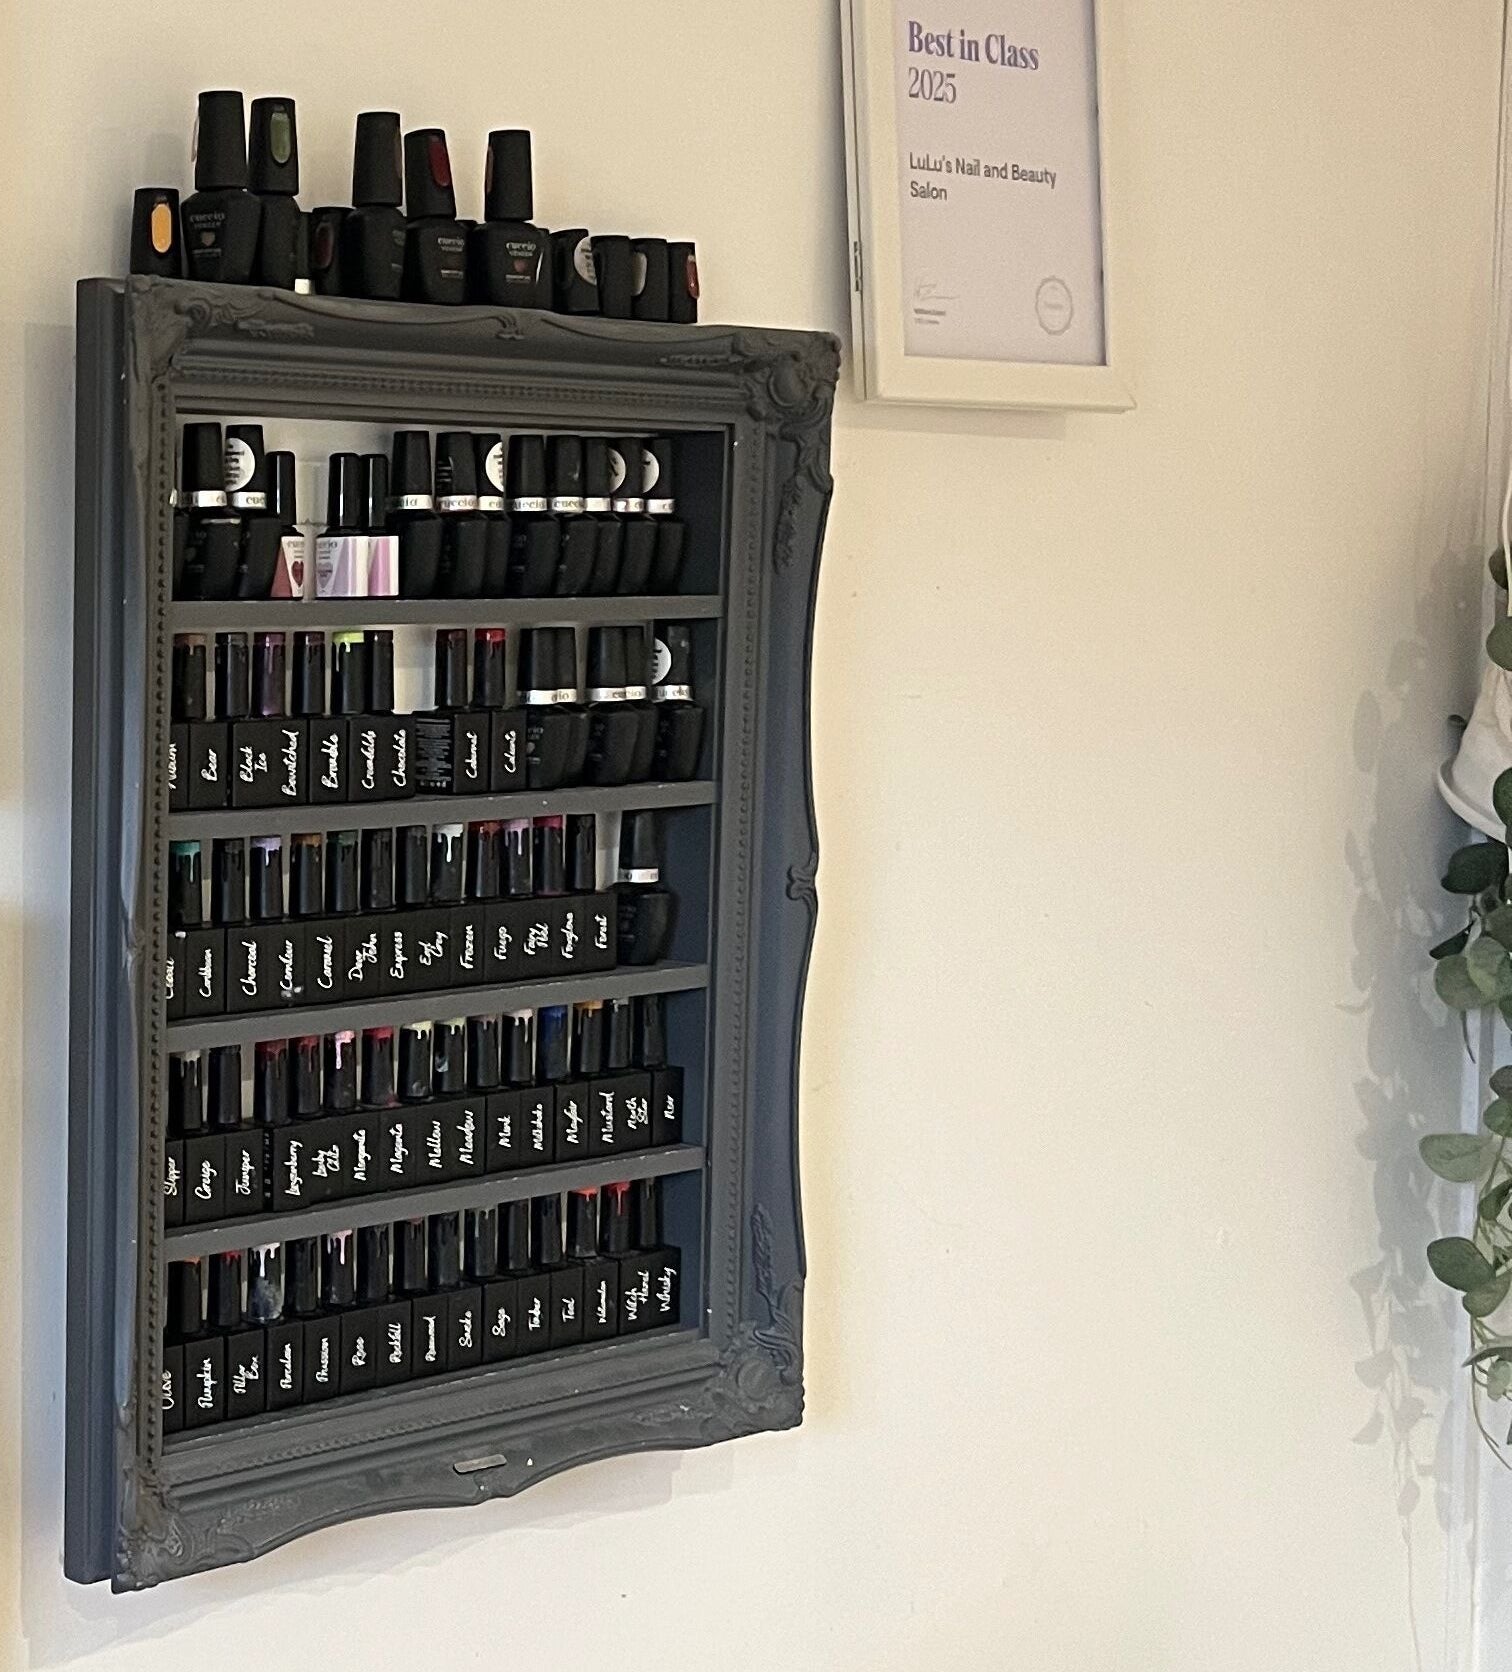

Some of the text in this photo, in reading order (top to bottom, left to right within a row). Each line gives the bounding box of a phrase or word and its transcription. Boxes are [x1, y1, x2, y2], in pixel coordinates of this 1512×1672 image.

[908, 20, 1039, 70] Best in Class
[908, 66, 957, 104] 2025
[909, 152, 1057, 189] LuLu's Nail and Beauty
[909, 181, 948, 201] Salon
[200, 748, 218, 782] Bear
[391, 729, 407, 787] Chocolate
[360, 932, 378, 966] John
[459, 924, 474, 969] Frozen
[594, 914, 608, 949] Forest
[239, 940, 257, 996] Charcoal
[316, 935, 333, 989] Caramel
[455, 1109, 476, 1165] Meadow
[598, 1091, 615, 1144] Mustard
[388, 1123, 409, 1174] Magenta
[426, 1120, 443, 1169] Mellow
[235, 1149, 255, 1195] Juniper
[561, 1297, 575, 1323] Teal
[196, 1357, 218, 1409] Pumpkin
